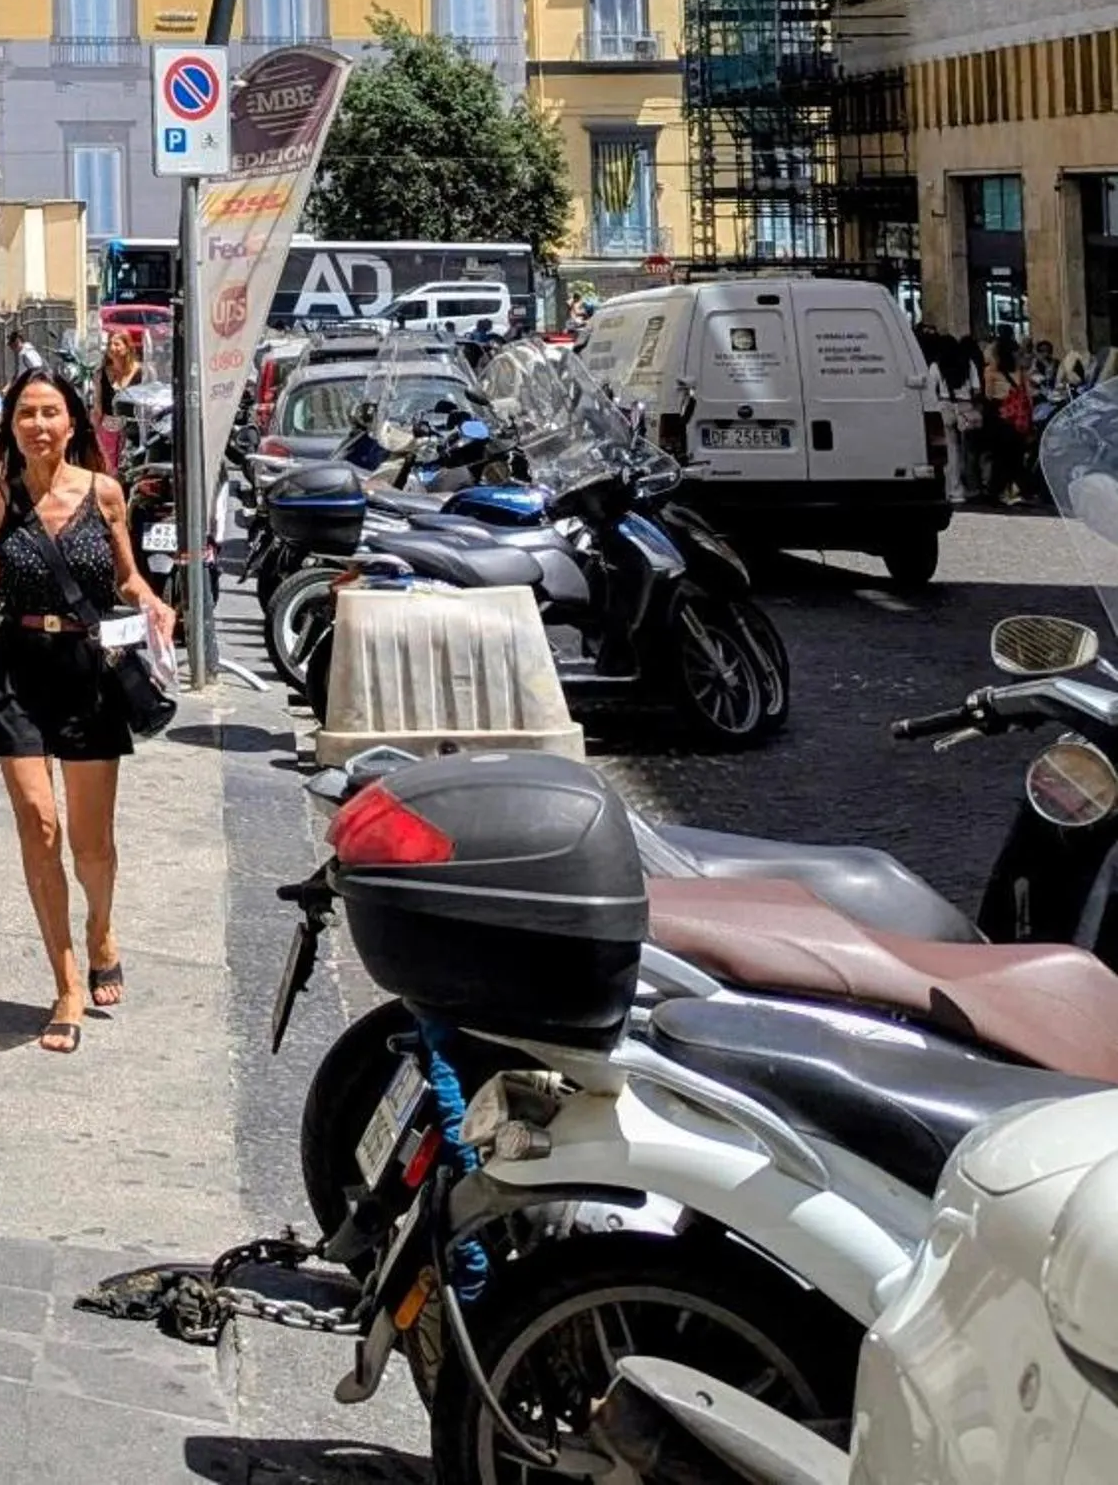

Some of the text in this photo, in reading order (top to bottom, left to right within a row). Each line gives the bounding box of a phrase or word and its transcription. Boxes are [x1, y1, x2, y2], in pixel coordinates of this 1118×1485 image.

[256, 84, 315, 114] MBE
[168, 130, 183, 151] P
[232, 140, 313, 171] EDIZION
